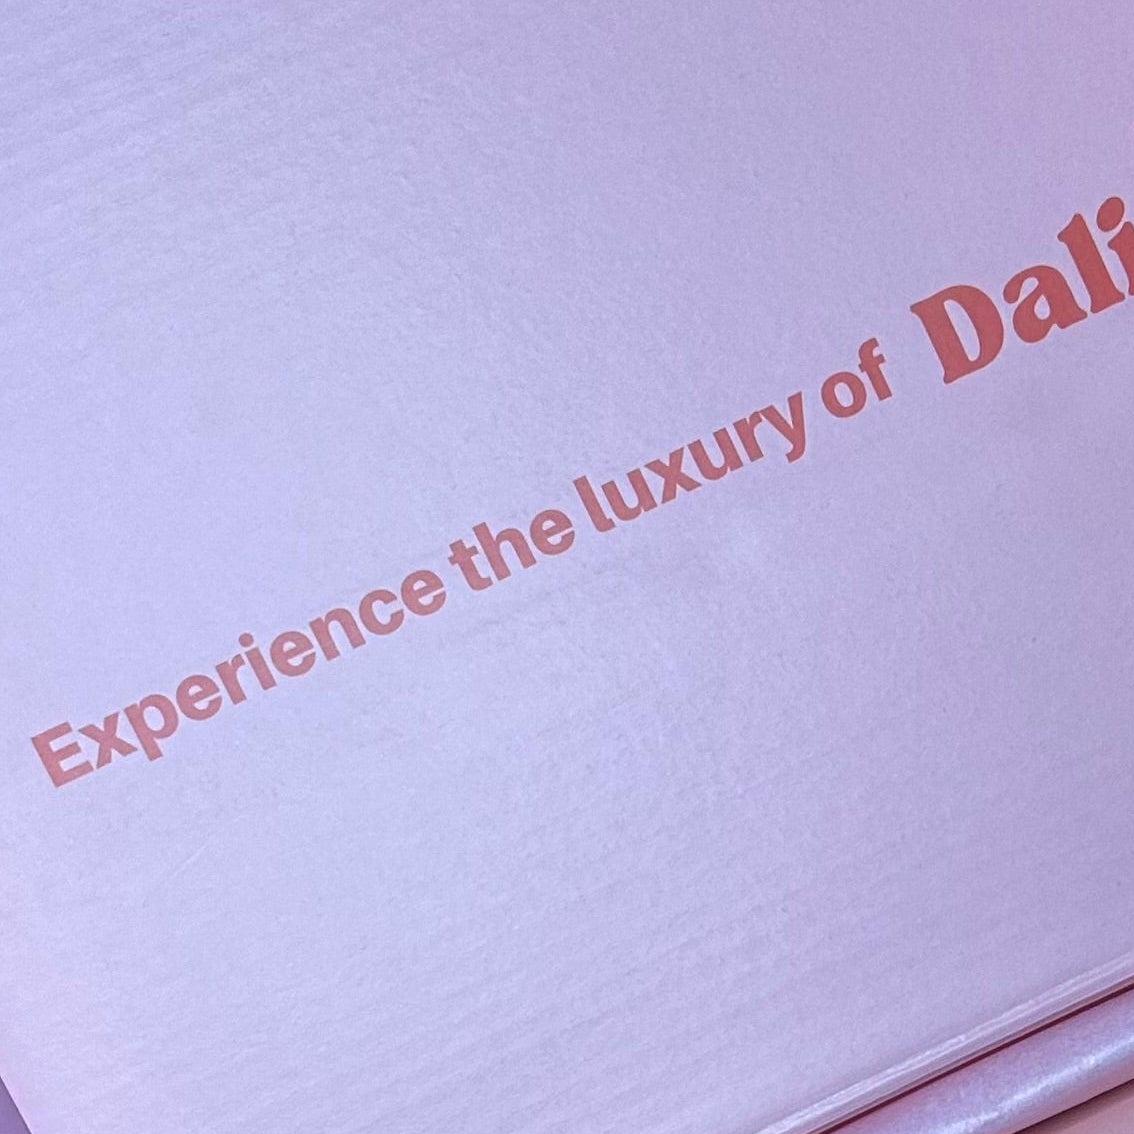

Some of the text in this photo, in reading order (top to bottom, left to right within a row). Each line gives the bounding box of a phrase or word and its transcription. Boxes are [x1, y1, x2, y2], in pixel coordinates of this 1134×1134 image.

[30, 568, 448, 788] Experience
[447, 507, 576, 591] the
[572, 391, 806, 532] luxury
[820, 337, 893, 418] of
